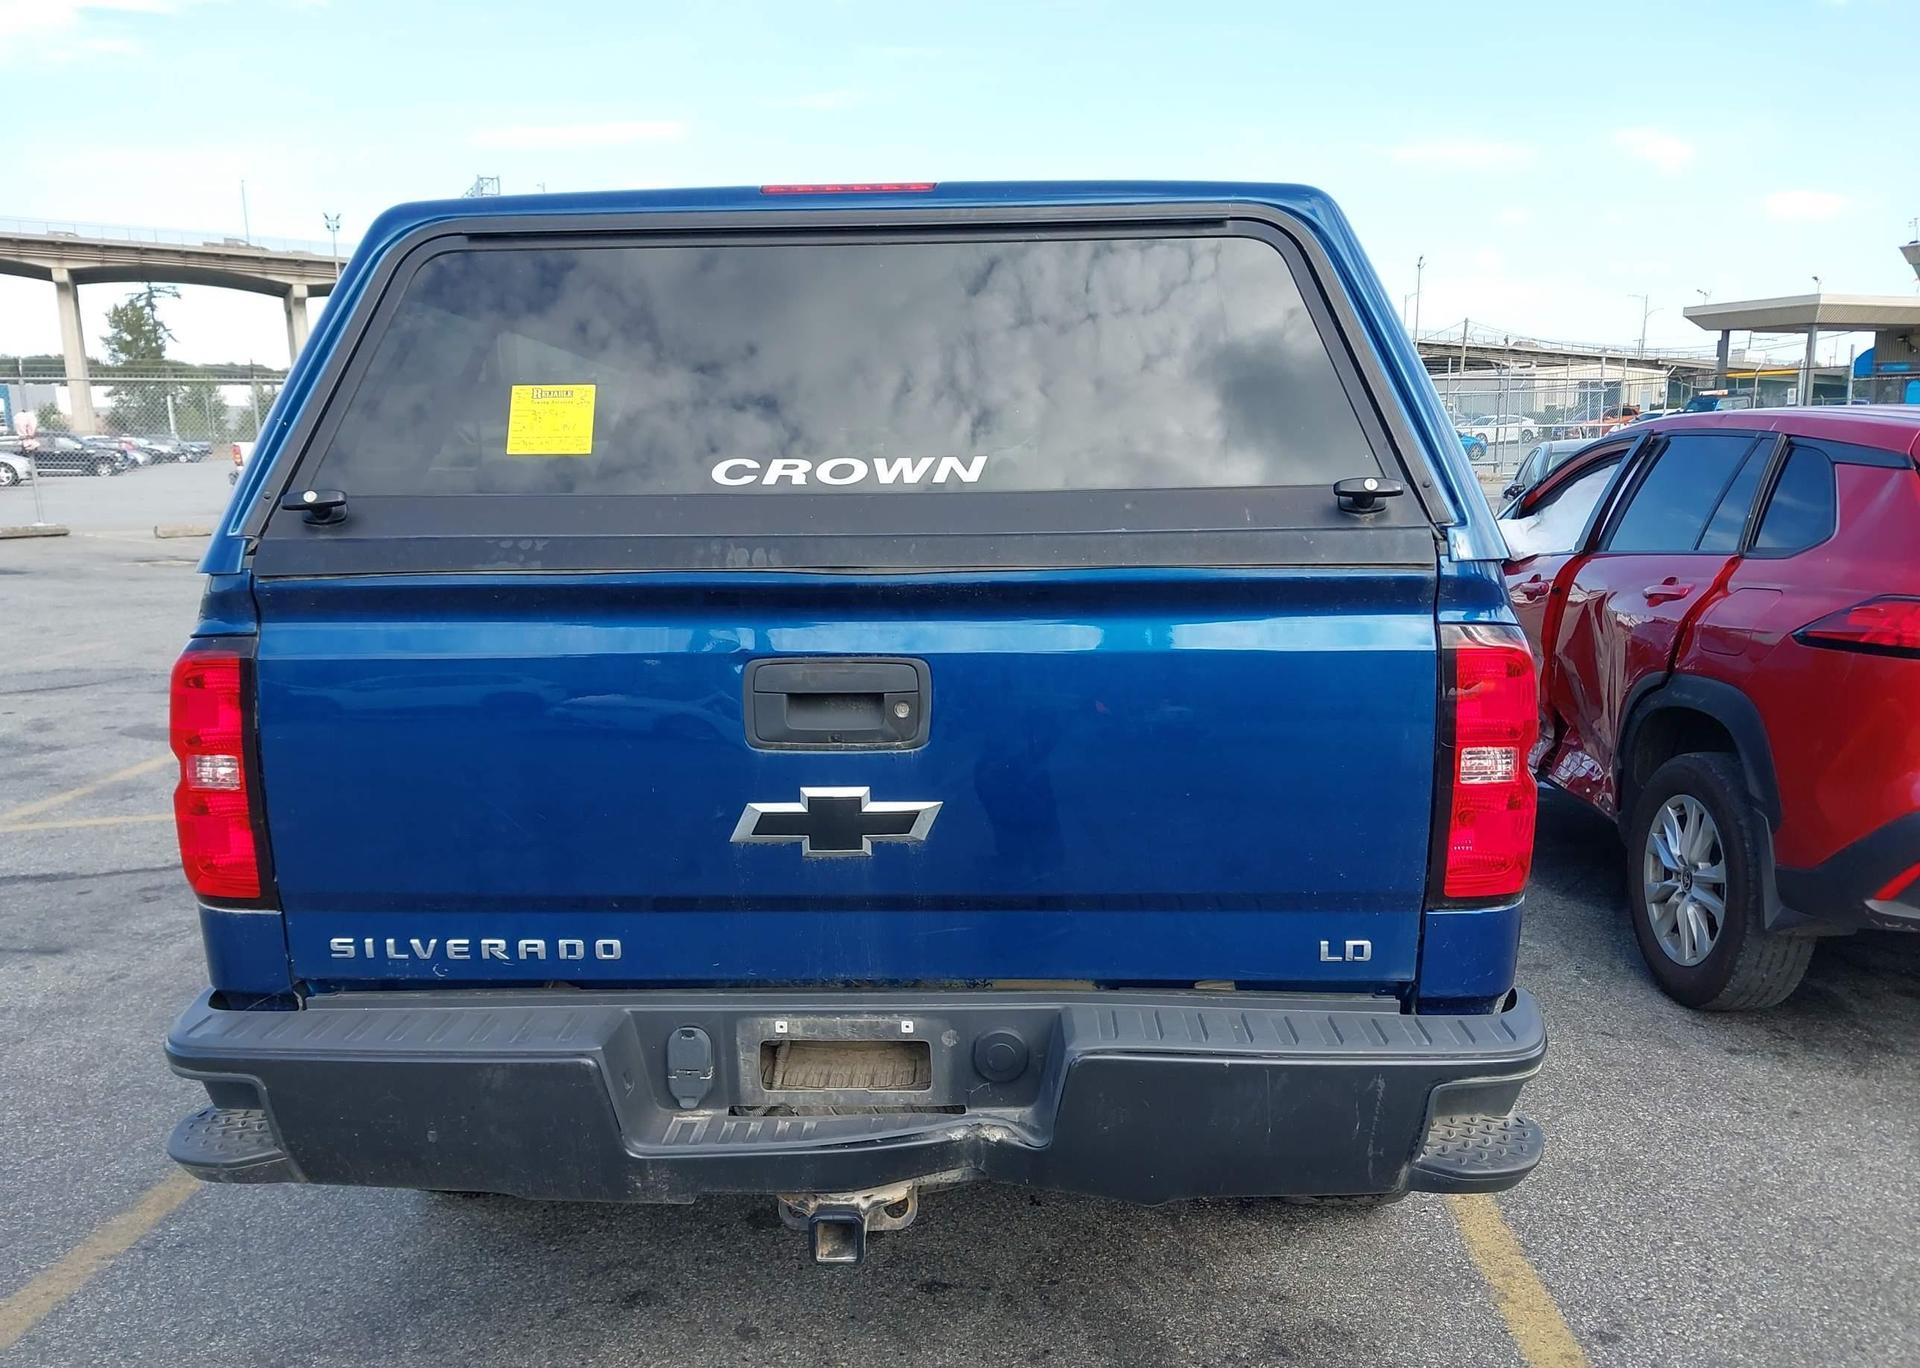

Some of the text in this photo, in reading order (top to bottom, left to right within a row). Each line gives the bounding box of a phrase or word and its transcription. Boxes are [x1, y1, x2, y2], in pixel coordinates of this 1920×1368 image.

[711, 455, 988, 486] CROWN
[330, 938, 623, 960] SILVERADO
[1320, 940, 1372, 962] LD
